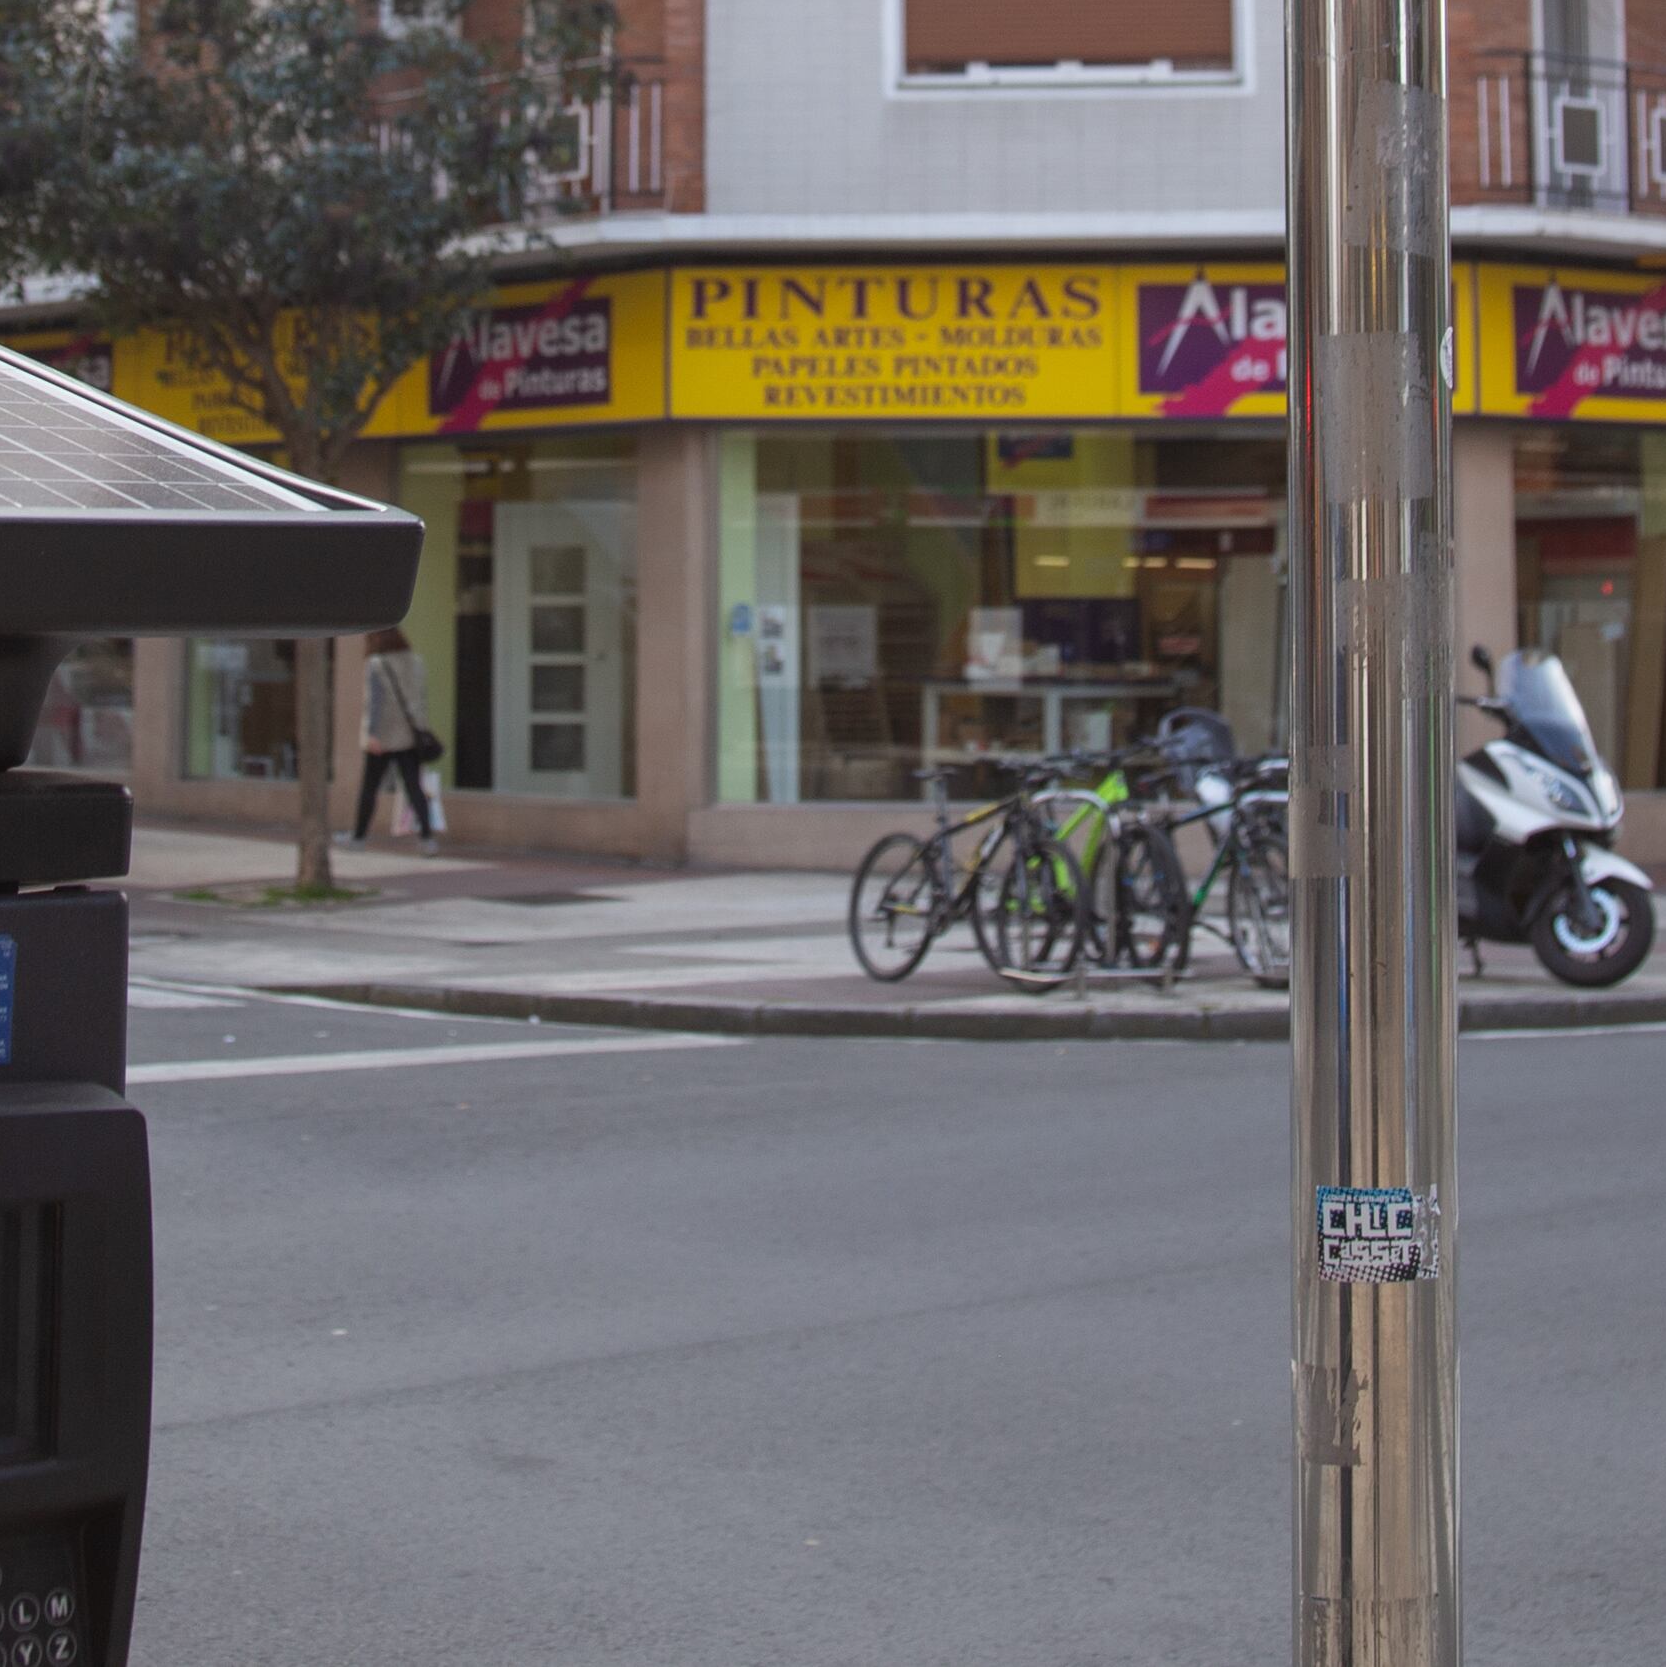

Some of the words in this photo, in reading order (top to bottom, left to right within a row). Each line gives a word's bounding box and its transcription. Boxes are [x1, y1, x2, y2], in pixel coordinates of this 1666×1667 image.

[691, 276, 1101, 321] PINTURAS
[686, 326, 800, 349] BELLAS
[813, 326, 906, 349] ARTES
[940, 326, 1102, 349] MOLDURAS
[438, 310, 608, 398] Alavesa
[753, 355, 881, 378] PAPELES
[893, 354, 1039, 378] PINTADOS
[503, 365, 607, 399] Pinturas
[1230, 356, 1270, 383] de
[1573, 361, 1599, 385] de
[764, 385, 1027, 408] REVESTIMIENTOS
[19, 1602, 31, 1624] L
[51, 1595, 68, 1618] M
[19, 1642, 33, 1666] Y
[55, 1636, 70, 1660] Z
